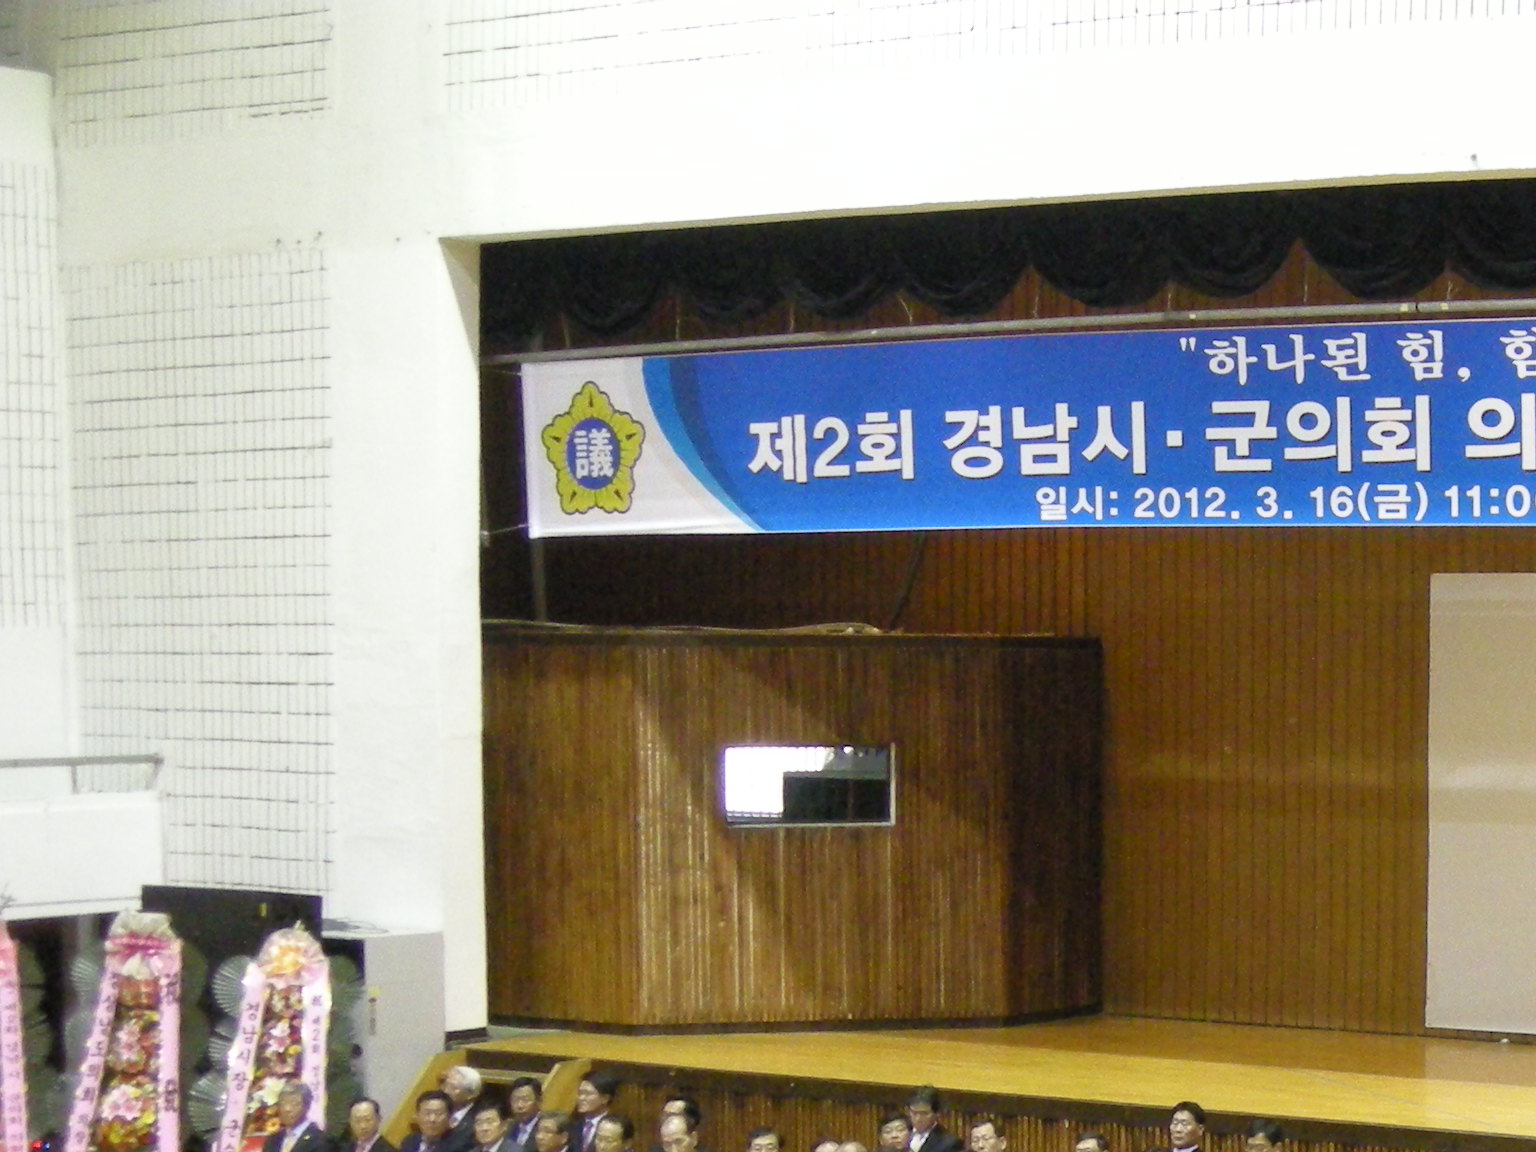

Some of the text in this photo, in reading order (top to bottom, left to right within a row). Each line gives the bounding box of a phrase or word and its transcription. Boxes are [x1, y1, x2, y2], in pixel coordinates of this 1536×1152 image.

[1179, 330, 1372, 386] "하나된
[1396, 329, 1472, 383] 힘,
[747, 409, 915, 484] 제2회
[1035, 485, 1119, 522] 일시:
[1133, 486, 1242, 521] 2012.
[1255, 487, 1293, 521] 3.
[1309, 482, 1430, 524] 16(금)
